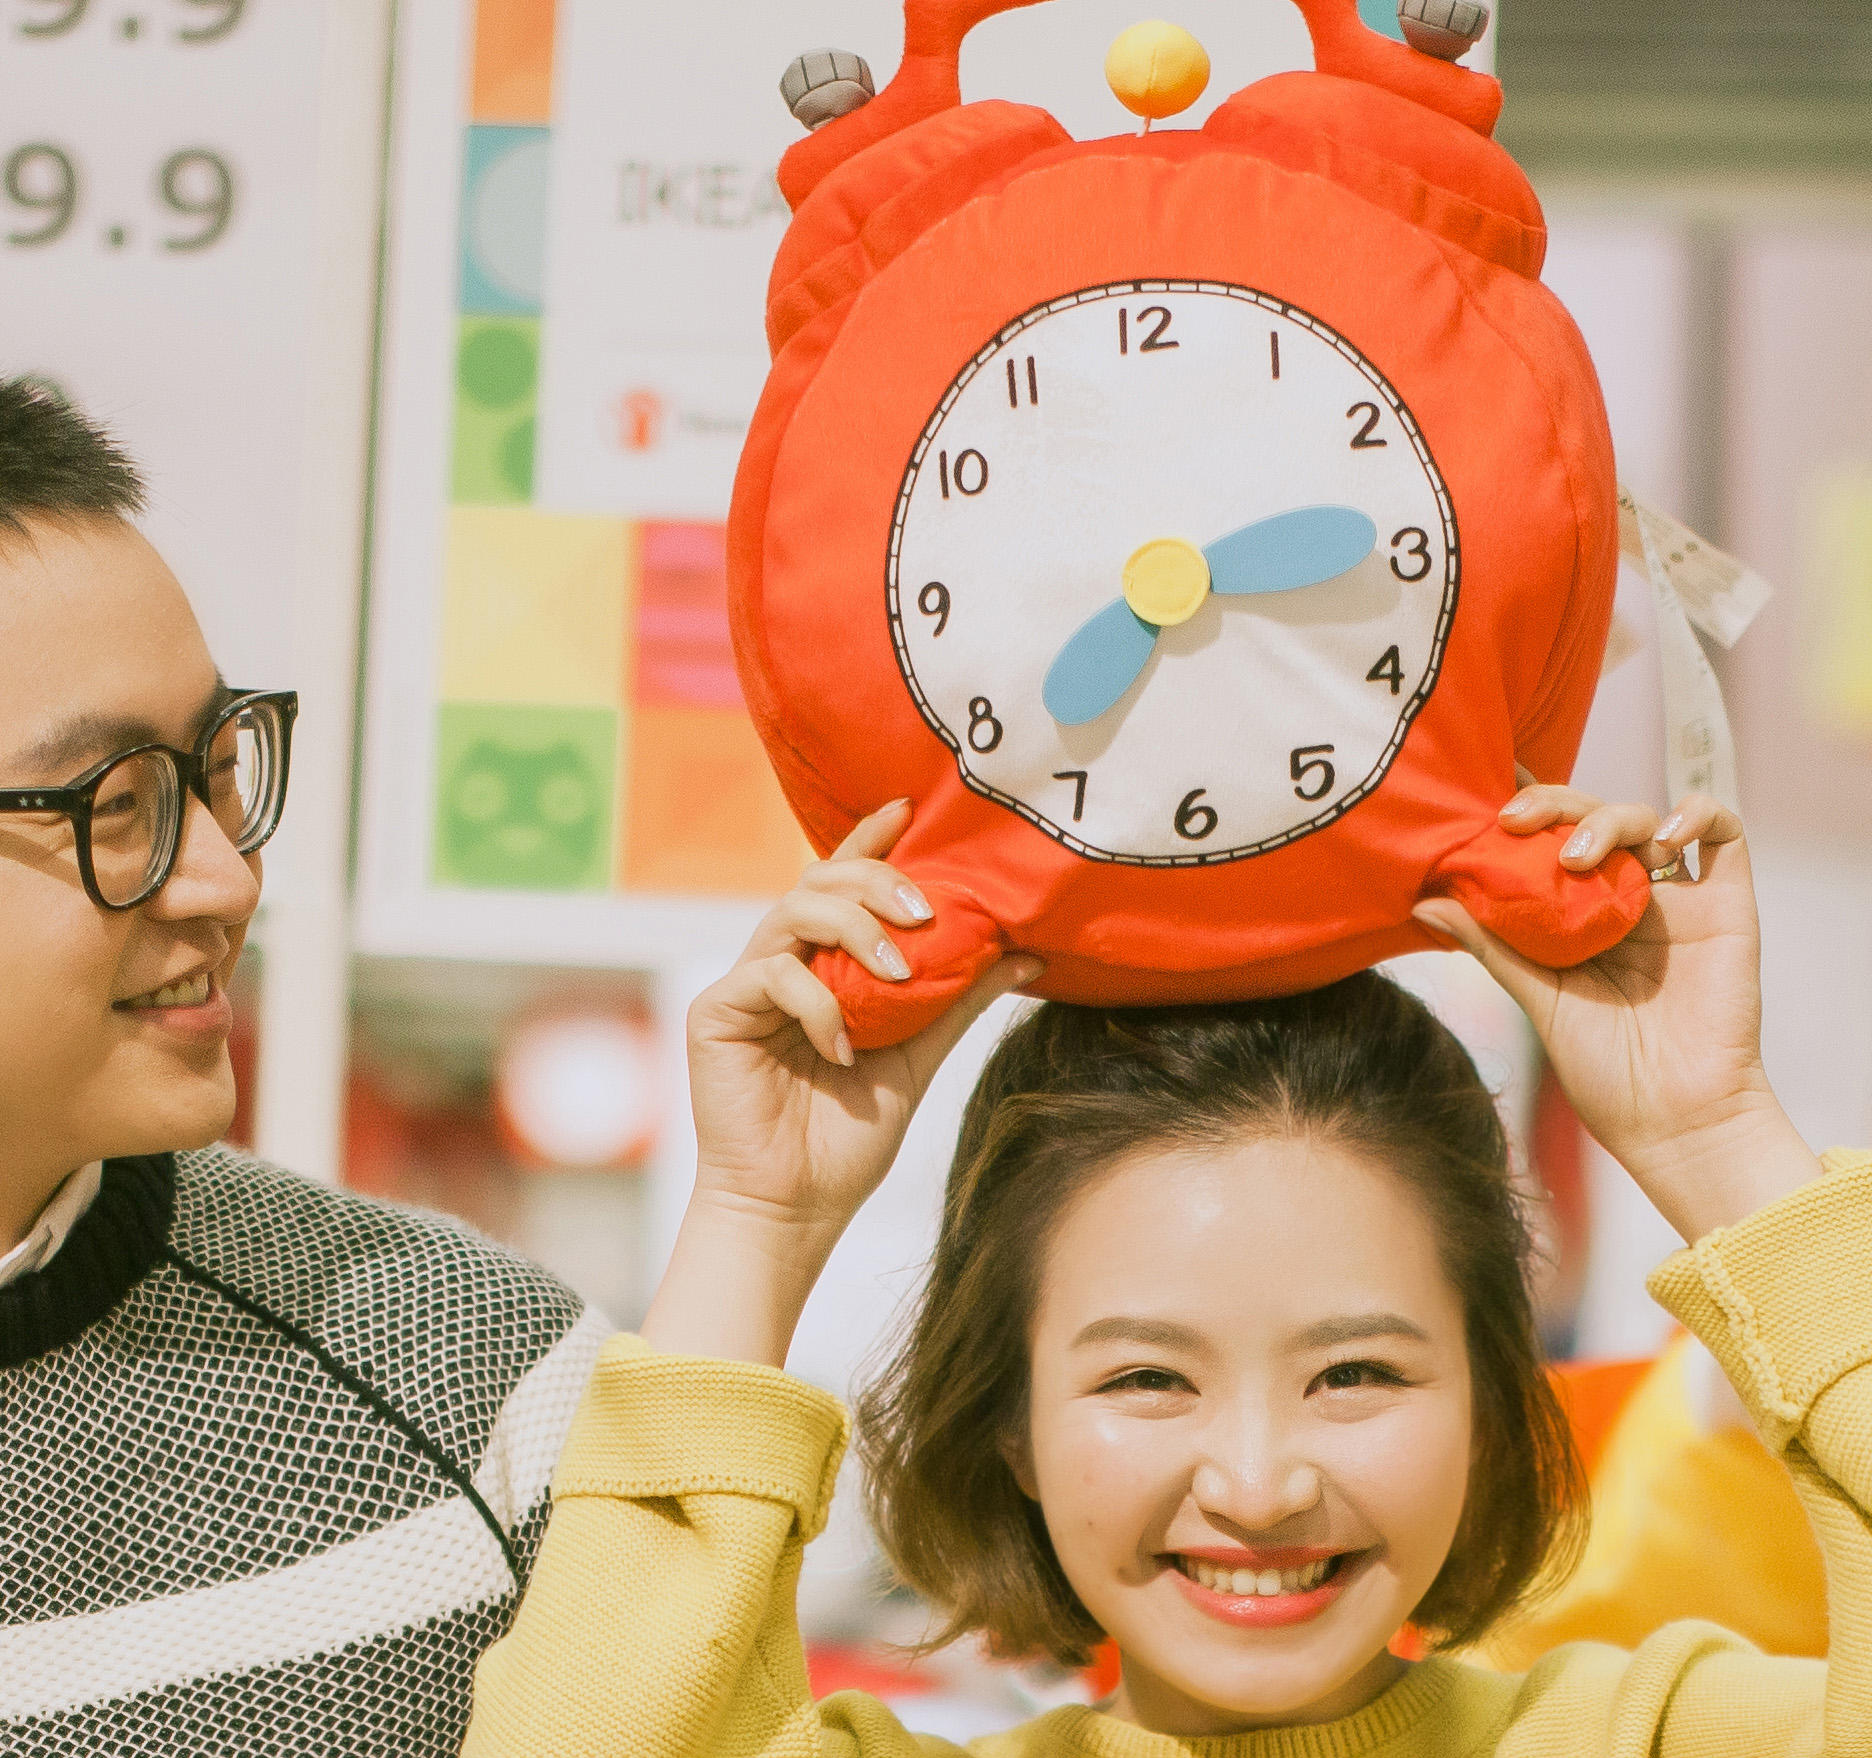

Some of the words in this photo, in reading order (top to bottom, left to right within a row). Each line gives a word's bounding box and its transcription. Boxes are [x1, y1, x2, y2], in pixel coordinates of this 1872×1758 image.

[1119, 306, 1179, 355] 12
[1270, 331, 1281, 379] 1
[1006, 356, 1038, 408] 11
[1345, 401, 1388, 449] 2
[939, 448, 989, 499] 10
[1390, 526, 1432, 582] 3
[917, 580, 952, 637] 9
[1366, 645, 1405, 694] 4
[968, 696, 1004, 754] 8
[1053, 770, 1088, 821] 7
[1290, 744, 1335, 800] 5
[1174, 788, 1218, 839] 6
